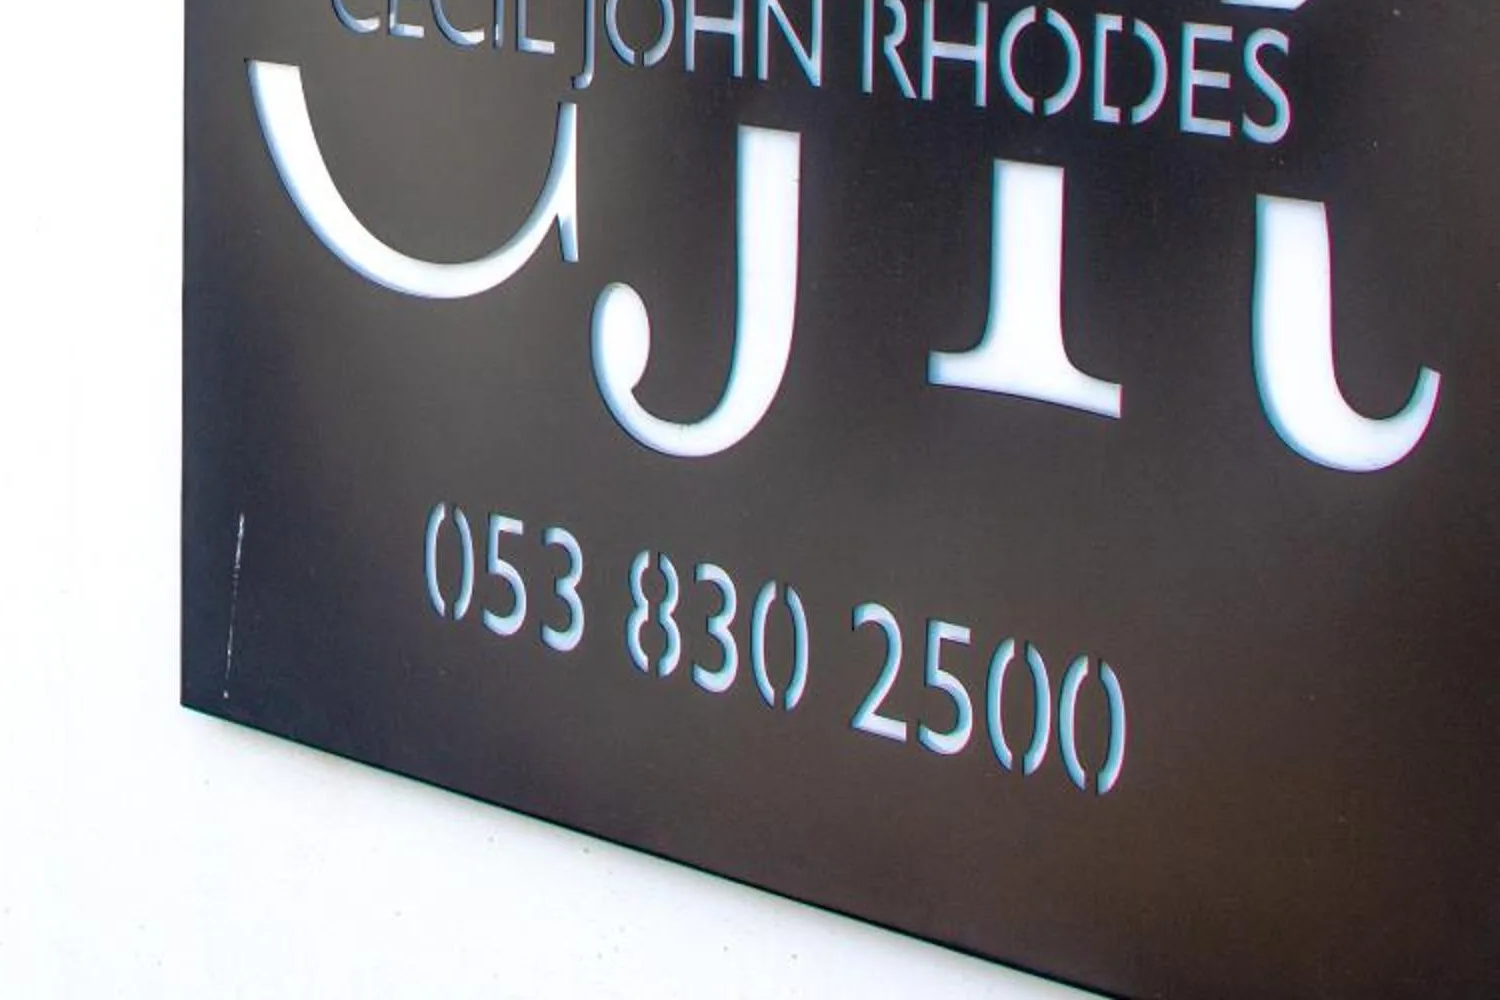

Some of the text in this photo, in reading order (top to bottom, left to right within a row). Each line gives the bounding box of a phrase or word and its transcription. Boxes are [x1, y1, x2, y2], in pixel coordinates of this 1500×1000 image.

[424, 500, 1129, 796] 053 830 2500
